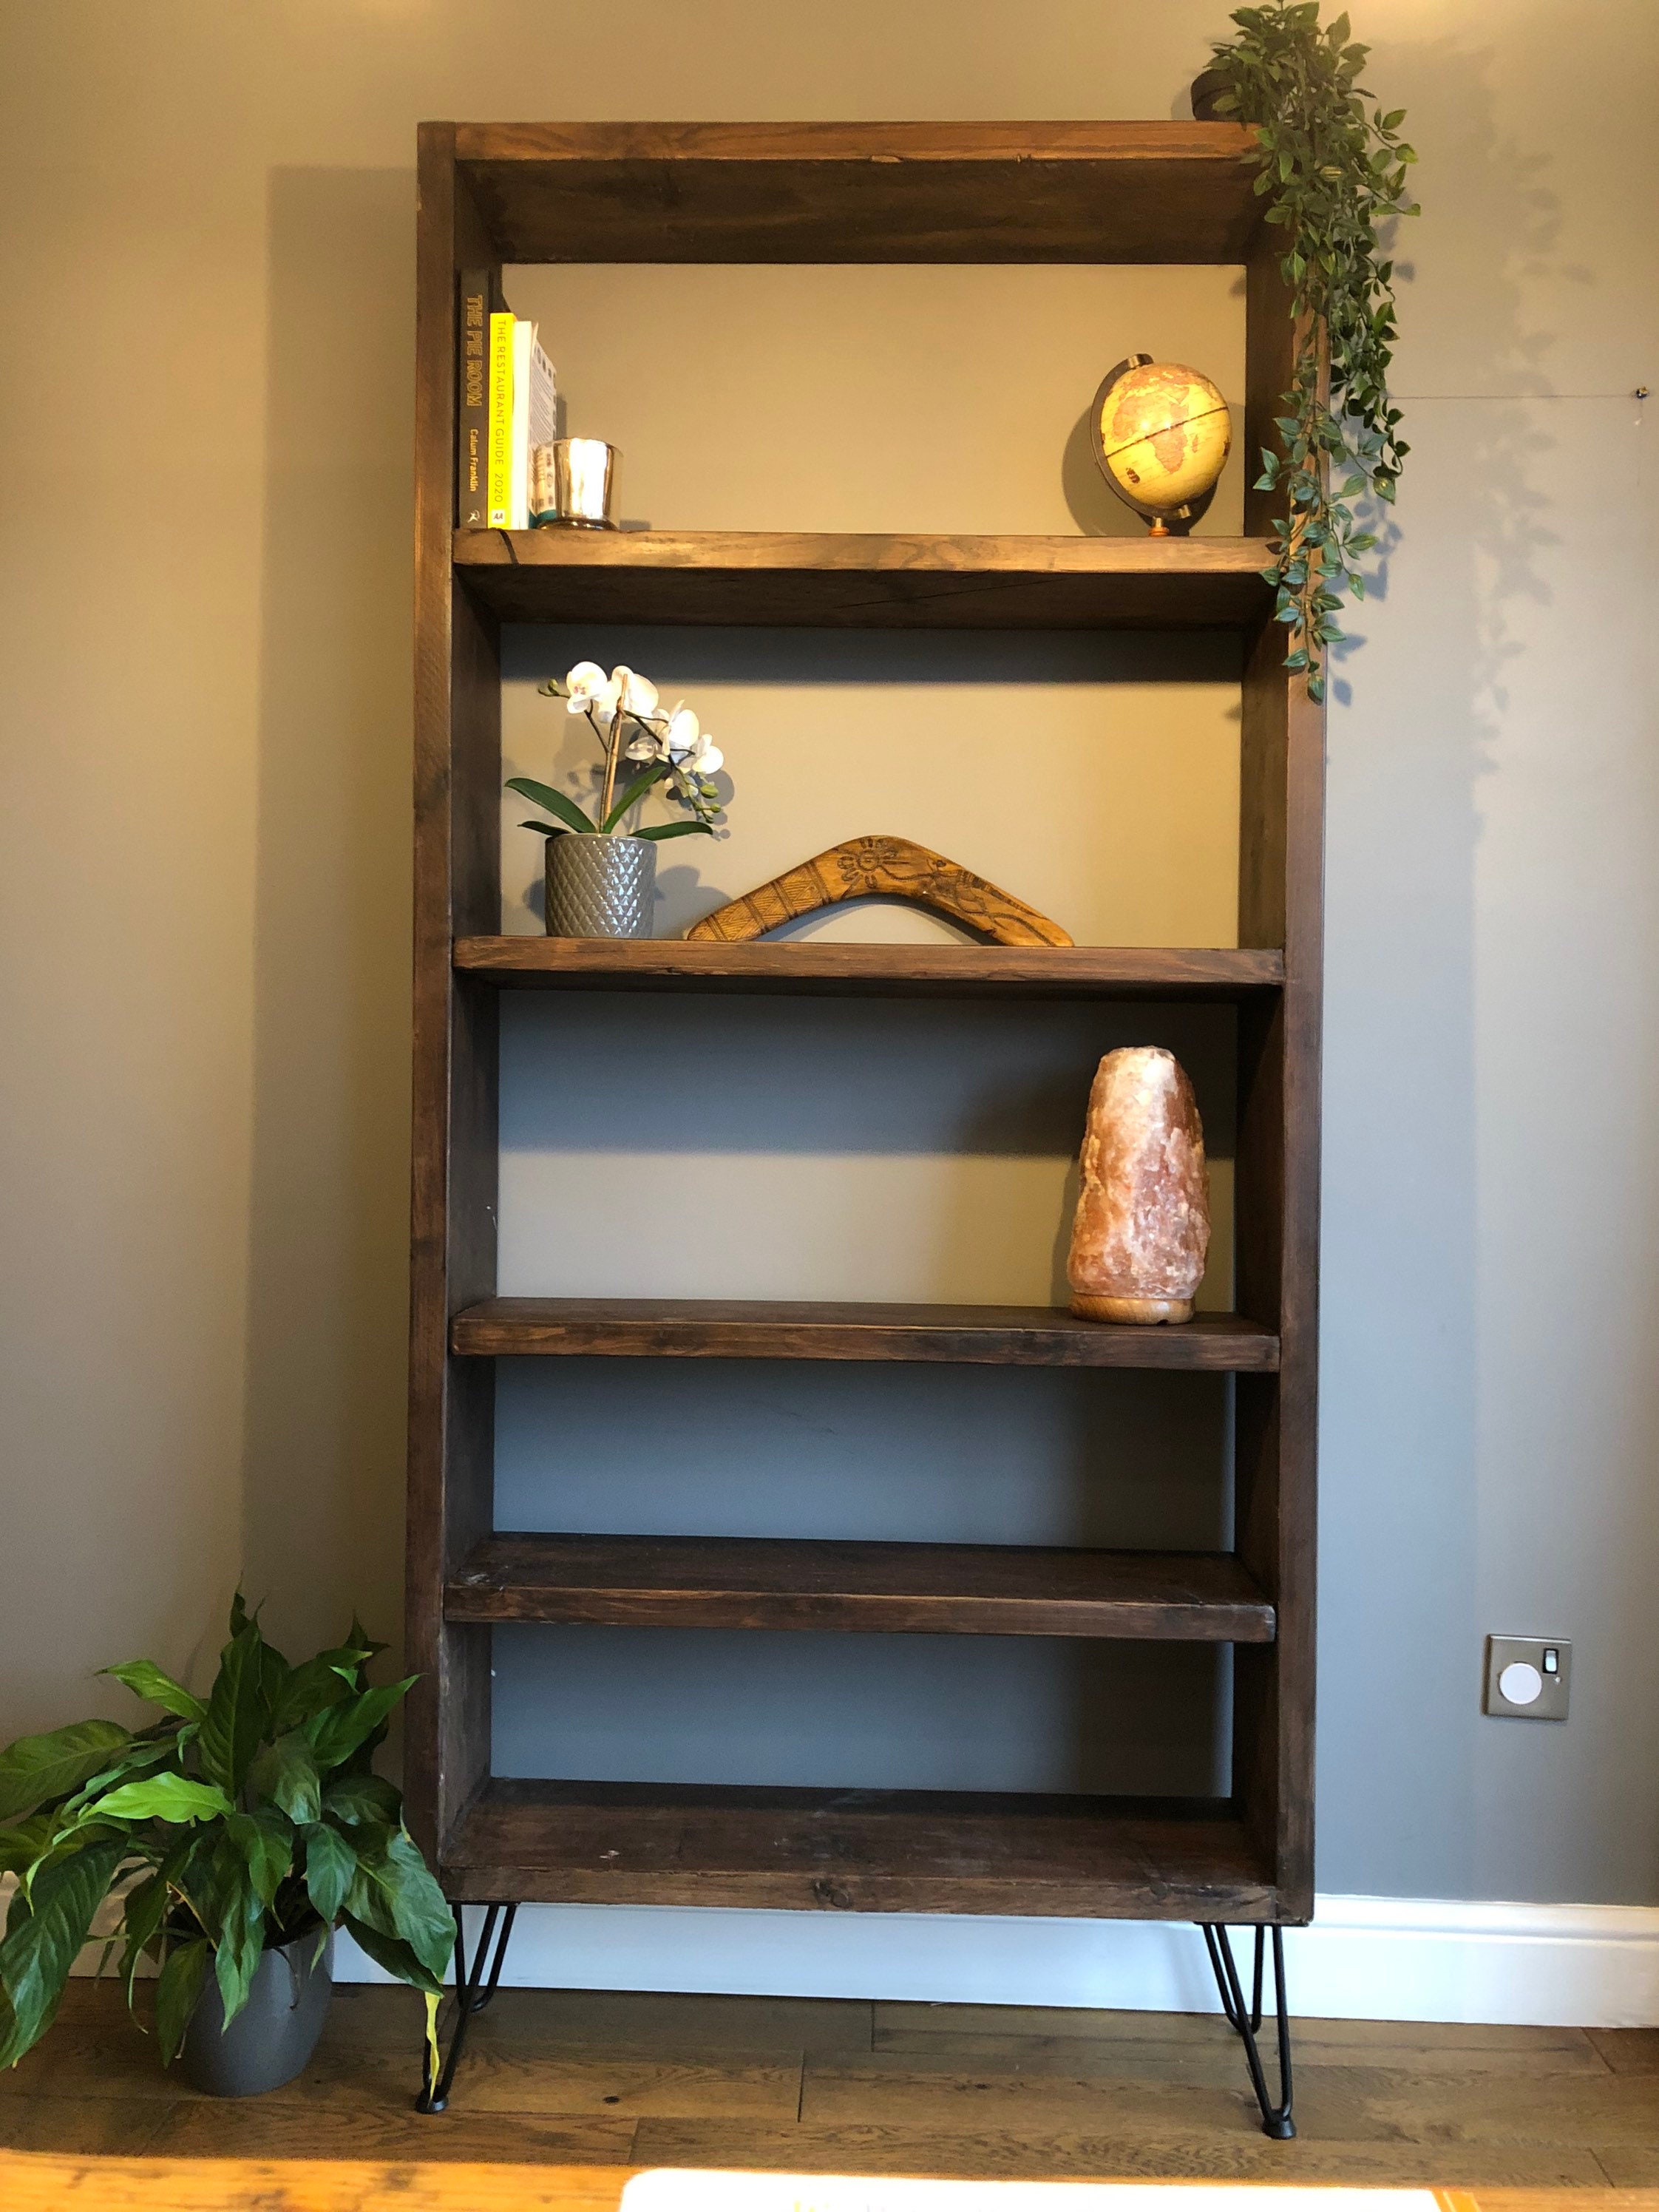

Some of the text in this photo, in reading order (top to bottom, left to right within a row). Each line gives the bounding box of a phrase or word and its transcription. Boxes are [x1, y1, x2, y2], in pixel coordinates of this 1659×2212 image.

[467, 295, 483, 407] THE PIE ROOM
[469, 429, 478, 492] Calum Franklin
[494, 319, 506, 503] THE RESTAURANT GUIDE 2020
